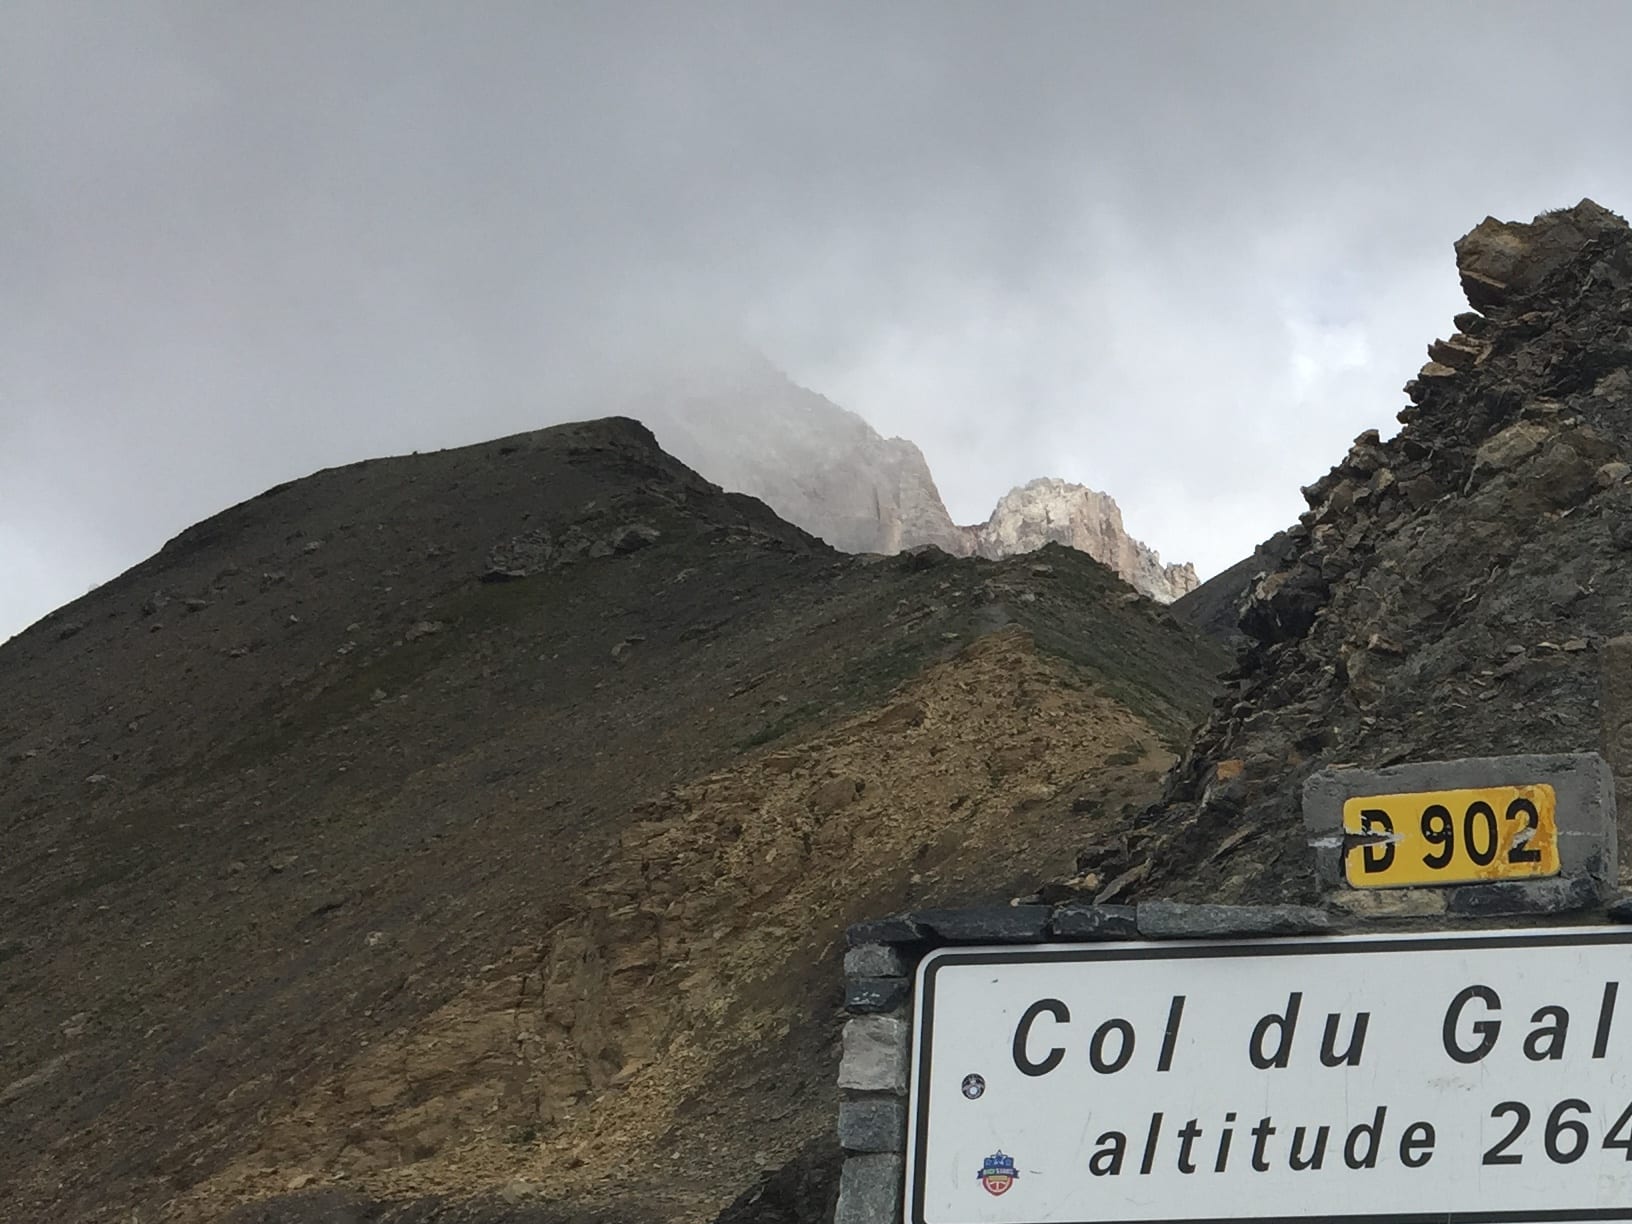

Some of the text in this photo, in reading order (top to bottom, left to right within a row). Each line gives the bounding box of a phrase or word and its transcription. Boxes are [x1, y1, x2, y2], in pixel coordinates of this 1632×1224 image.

[1360, 797, 1542, 874] D 902
[1012, 995, 1186, 1077] Col
[1249, 991, 1371, 1070] du
[1088, 1105, 1436, 1177] altitude
